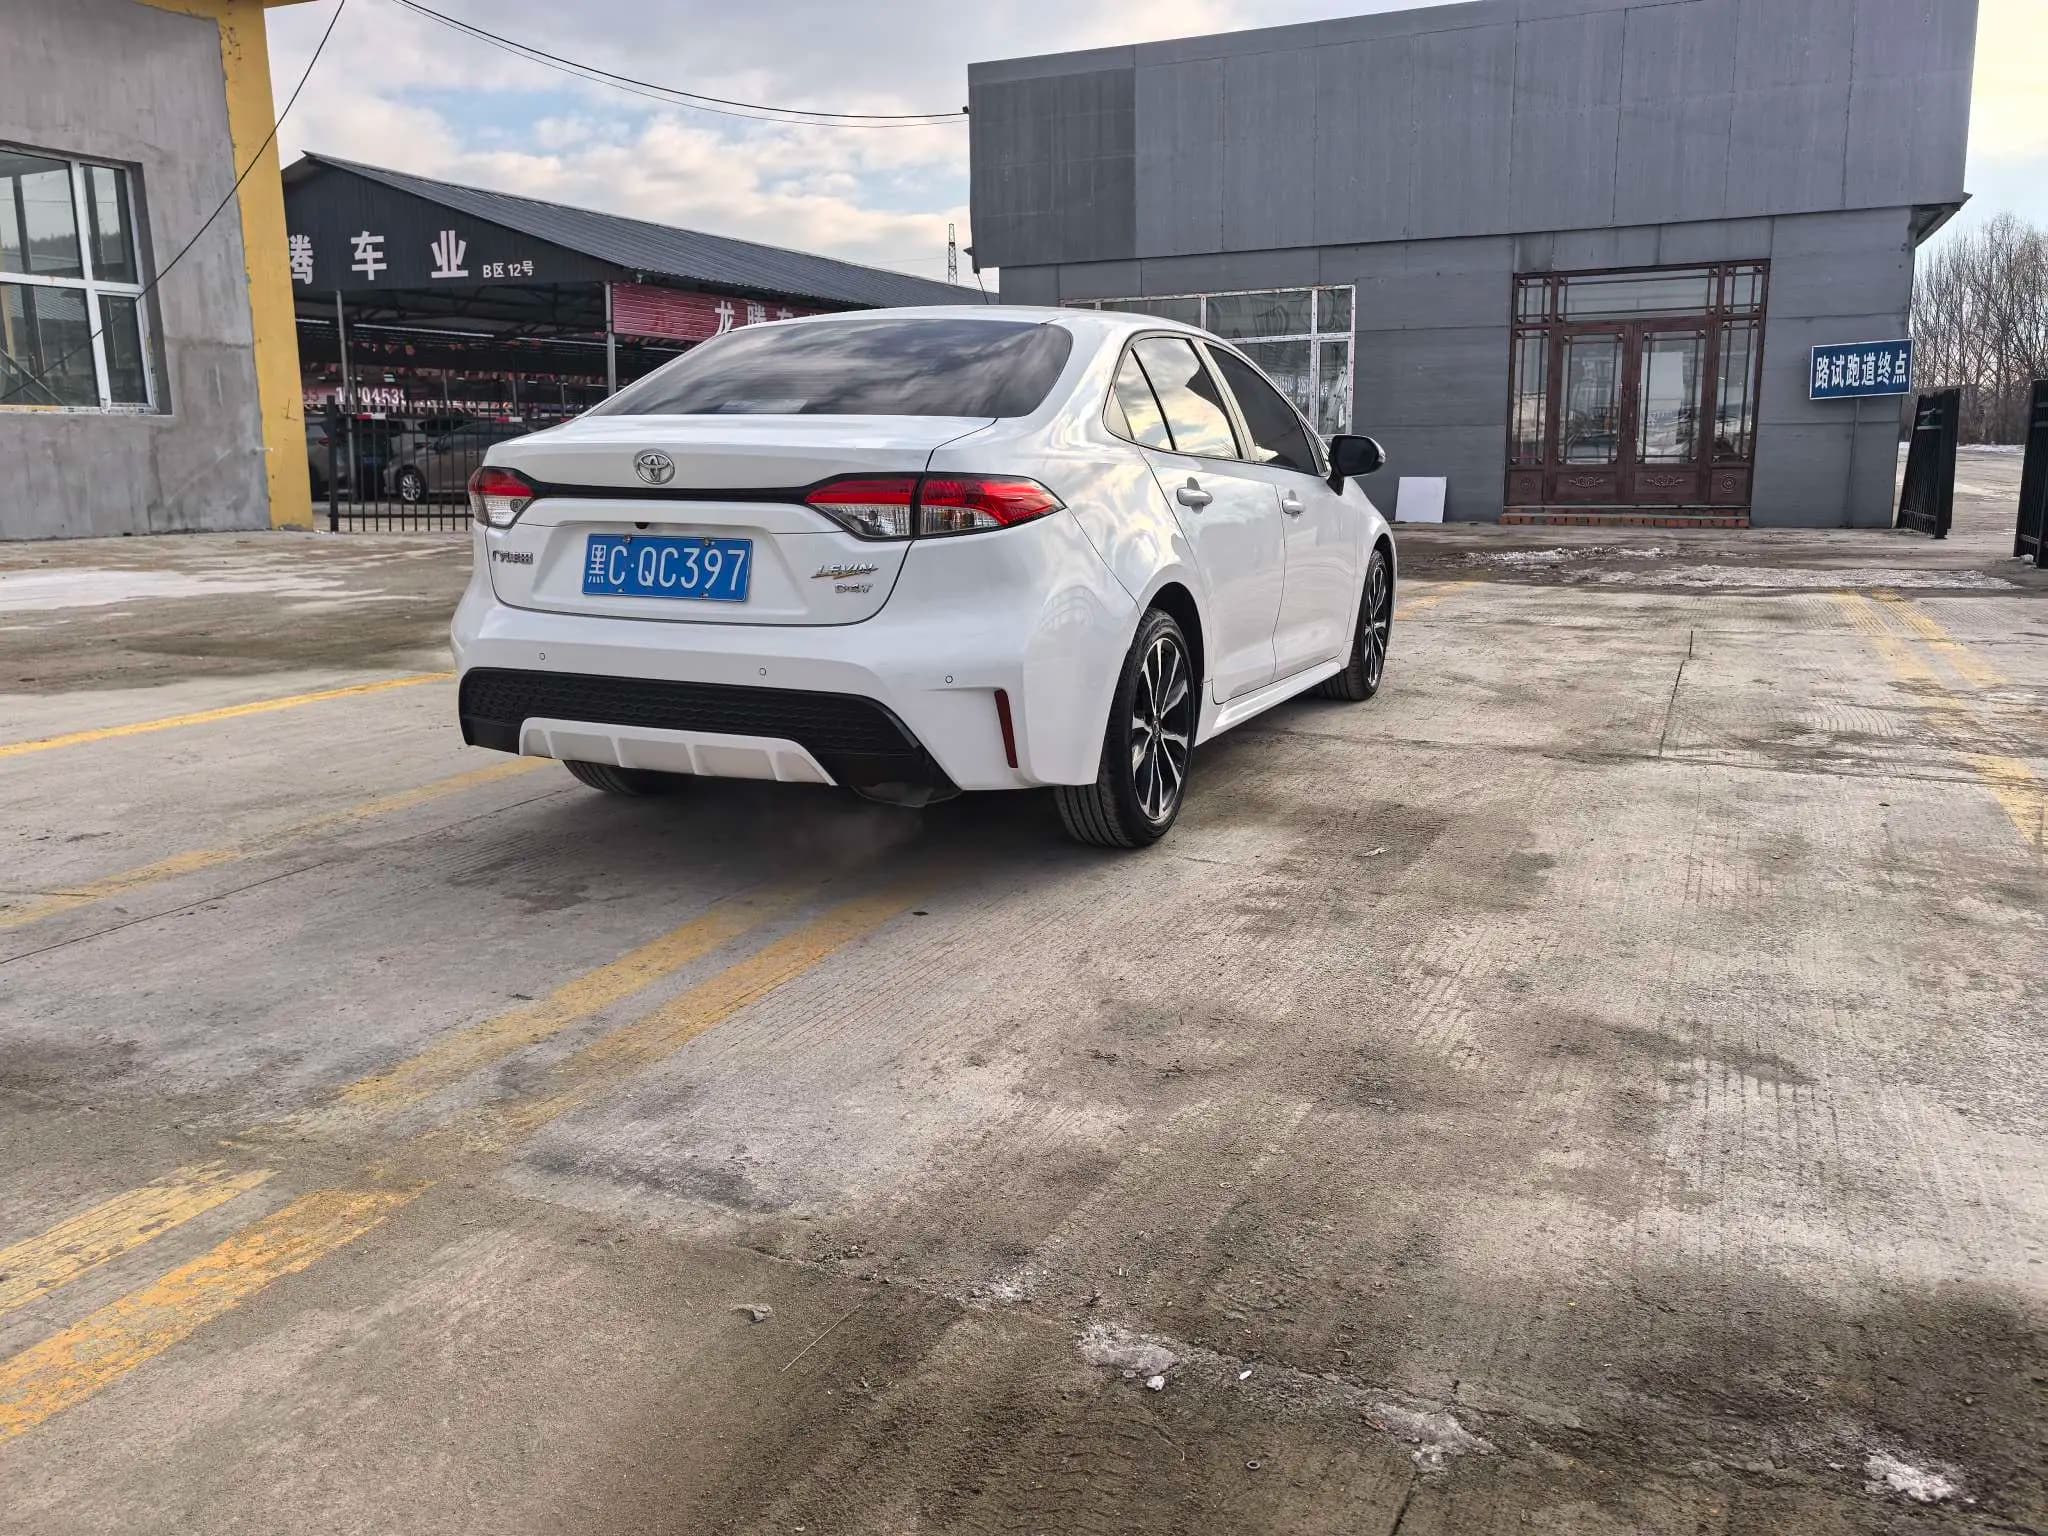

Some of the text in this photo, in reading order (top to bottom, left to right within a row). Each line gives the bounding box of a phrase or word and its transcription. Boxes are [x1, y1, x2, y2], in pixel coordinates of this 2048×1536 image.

[1814, 349, 1908, 390] 路试跑道终点
